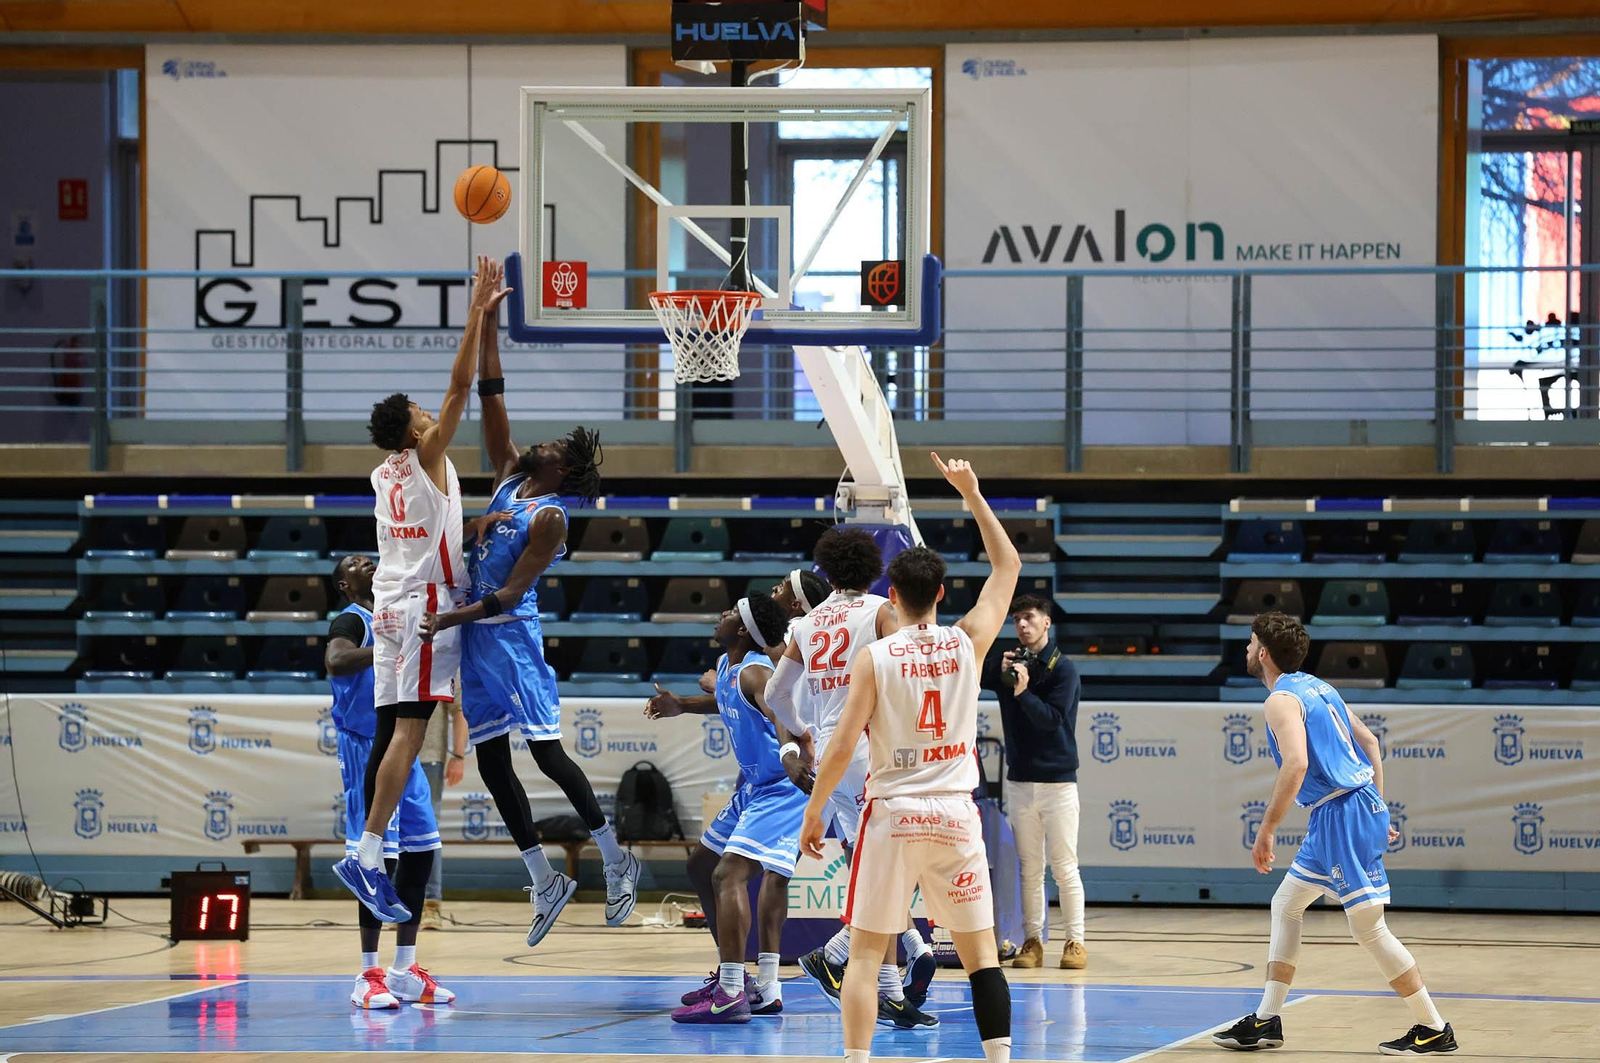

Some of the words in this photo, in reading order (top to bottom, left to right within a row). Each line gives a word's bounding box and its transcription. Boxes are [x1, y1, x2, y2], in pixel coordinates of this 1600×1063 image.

[675, 22, 796, 41] HUELVA
[1236, 244, 1293, 261] MAKE
[1298, 243, 1315, 260] IT
[1320, 242, 1401, 260] HAPPEN
[303, 335, 386, 349] NTEGRAL
[393, 335, 417, 349] DE
[389, 526, 429, 539] IXMA
[814, 610, 849, 626] STAINE
[808, 627, 850, 673] 22
[915, 690, 947, 740] 4
[92, 736, 143, 747] HUELVA
[221, 738, 272, 749] HUELVA
[607, 741, 658, 752] HUELVA
[922, 741, 966, 763] IXMA
[1125, 746, 1177, 757] HUELVA
[1392, 747, 1445, 758] HUELVA
[1529, 748, 1584, 760] HUELVA
[107, 822, 158, 833] HUELVA
[237, 824, 288, 835] HUELVA
[1143, 834, 1195, 845] HUELVA
[1411, 836, 1465, 847] HUELVA
[199, 894, 239, 931] 17
